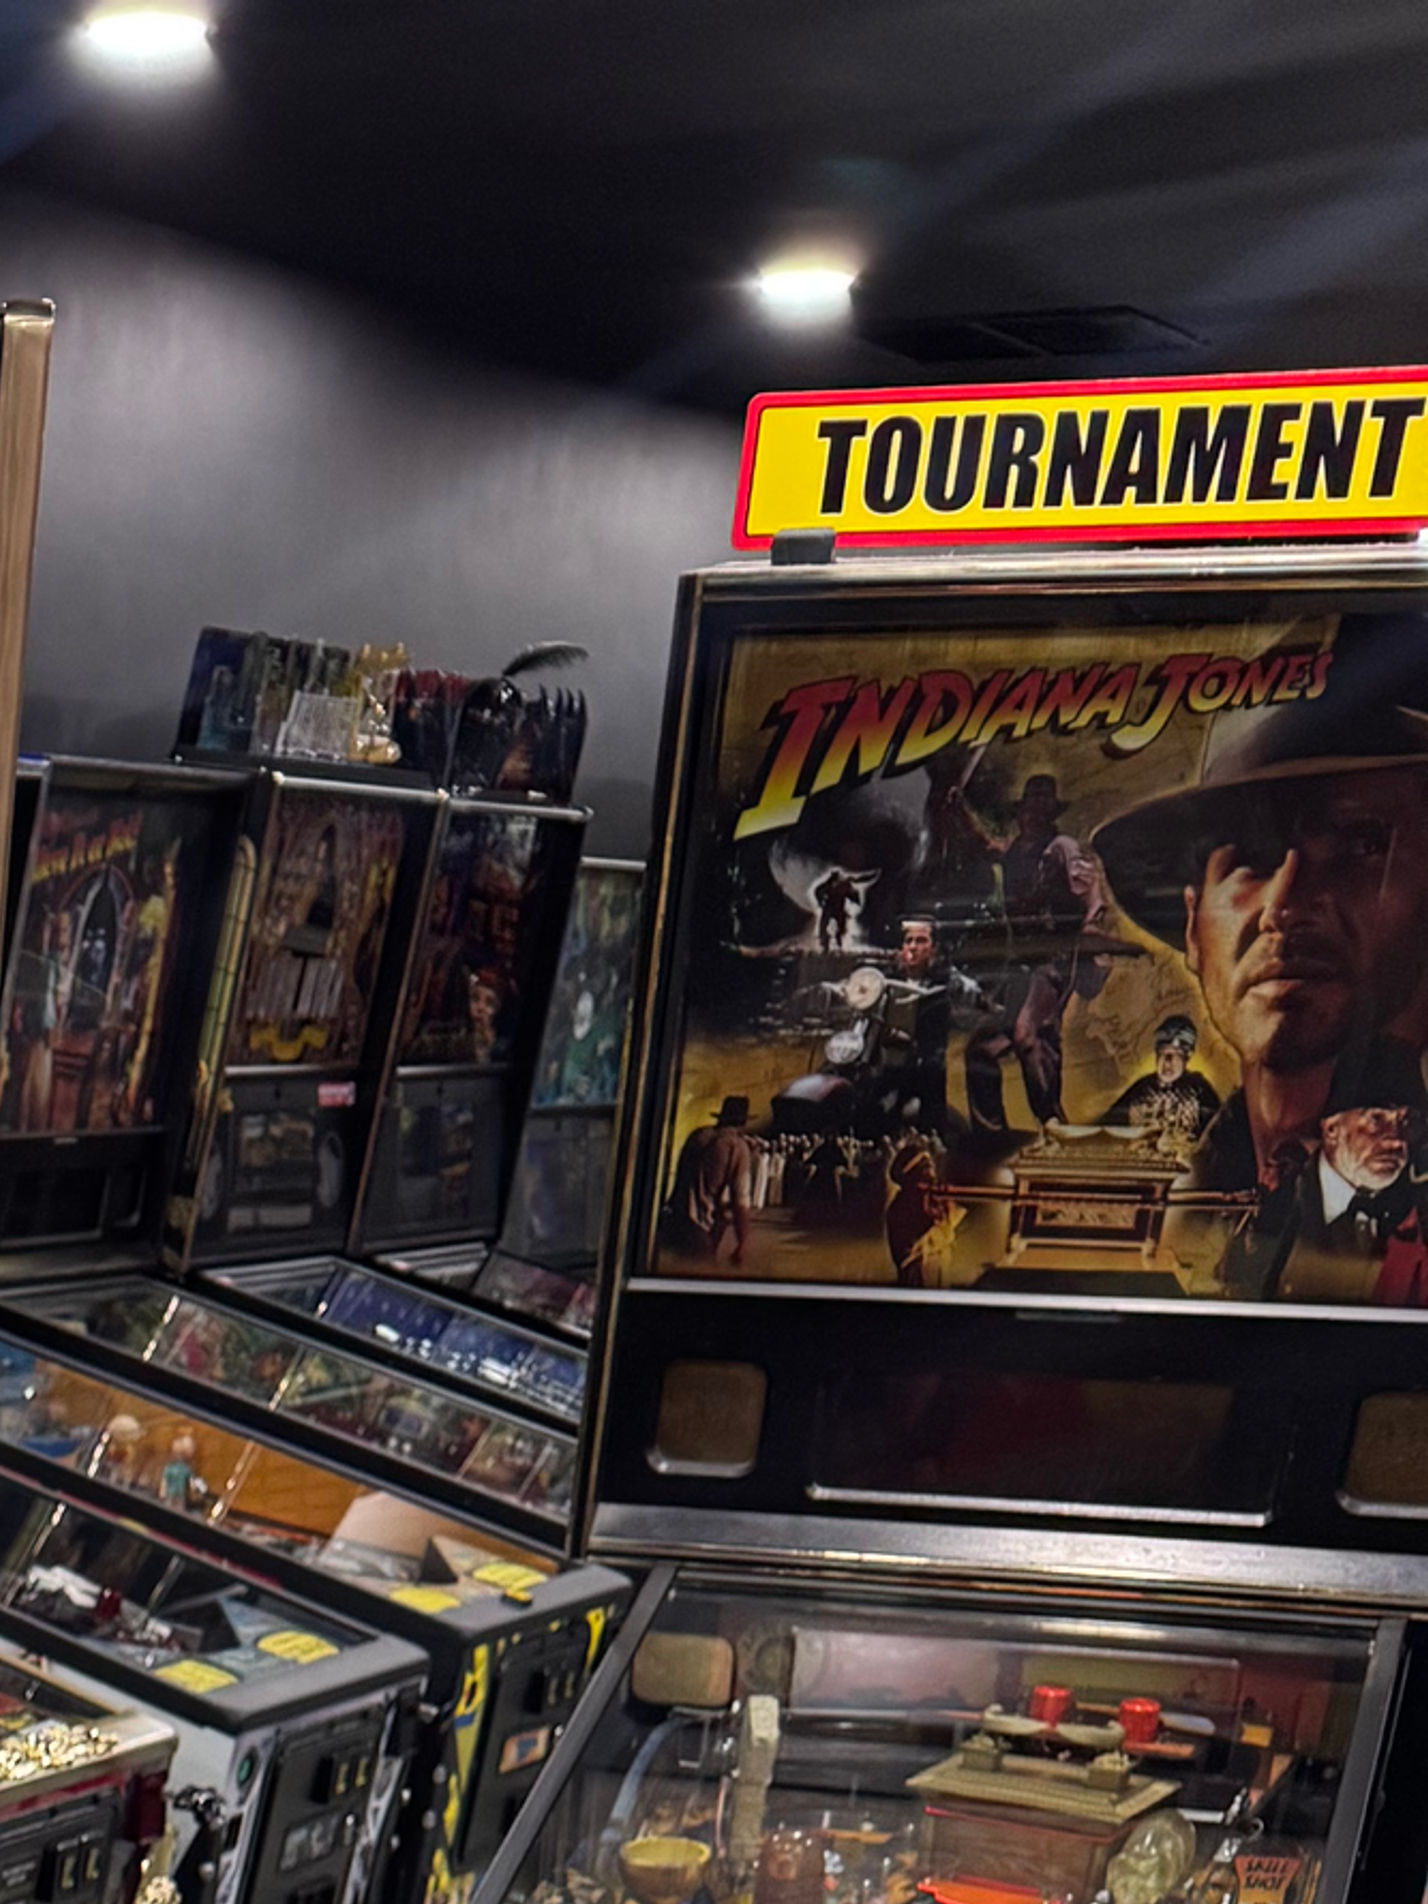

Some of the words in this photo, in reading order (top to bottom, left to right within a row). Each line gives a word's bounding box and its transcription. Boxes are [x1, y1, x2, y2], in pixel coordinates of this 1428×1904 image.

[816, 397, 1427, 514] TOURNAMENT
[733, 662, 1141, 841] INDIANA
[1102, 652, 1334, 758] JONES
